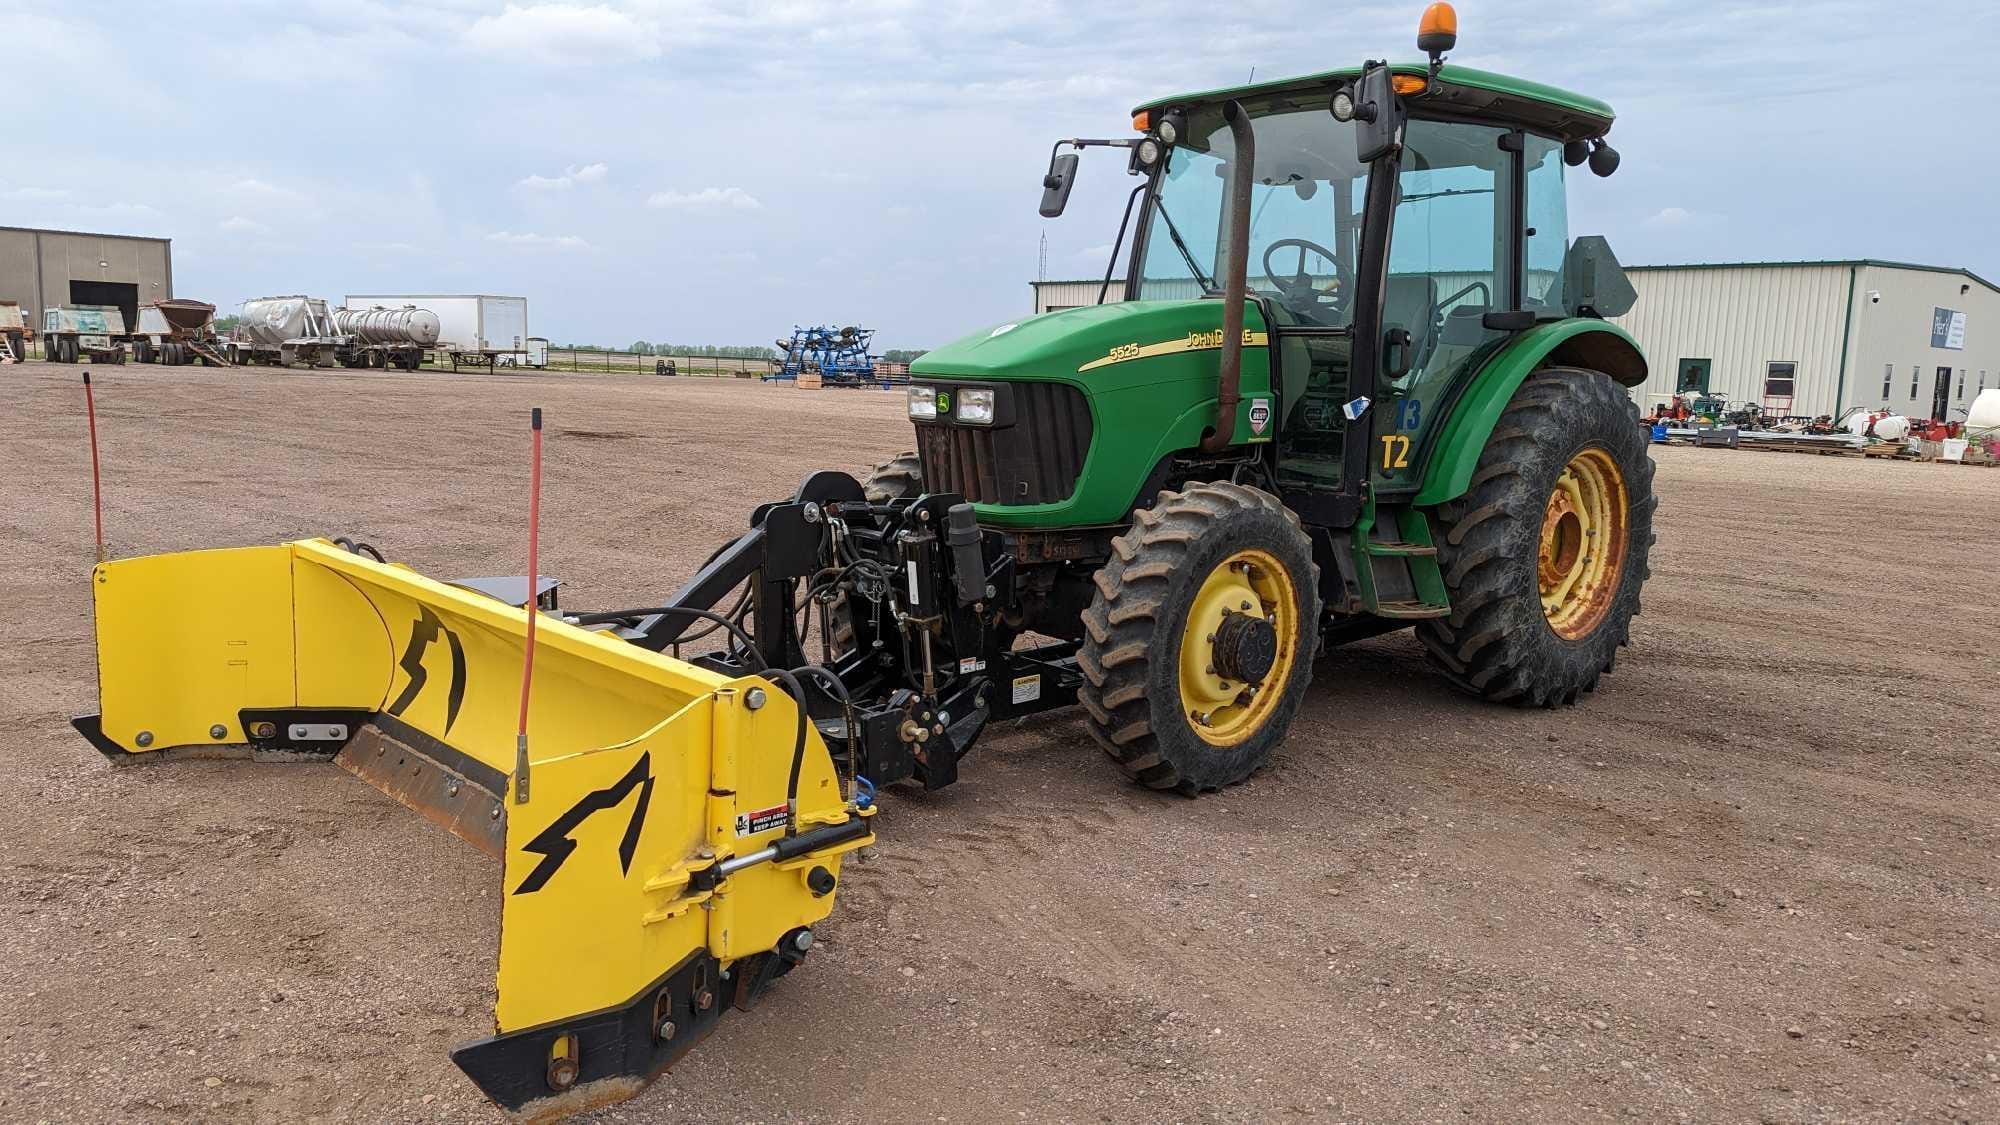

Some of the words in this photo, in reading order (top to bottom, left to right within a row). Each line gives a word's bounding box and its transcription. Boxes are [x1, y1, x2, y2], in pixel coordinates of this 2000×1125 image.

[1187, 330, 1215, 347] JOHN
[1109, 343, 1140, 361] 5525
[1381, 435, 1409, 469] T2
